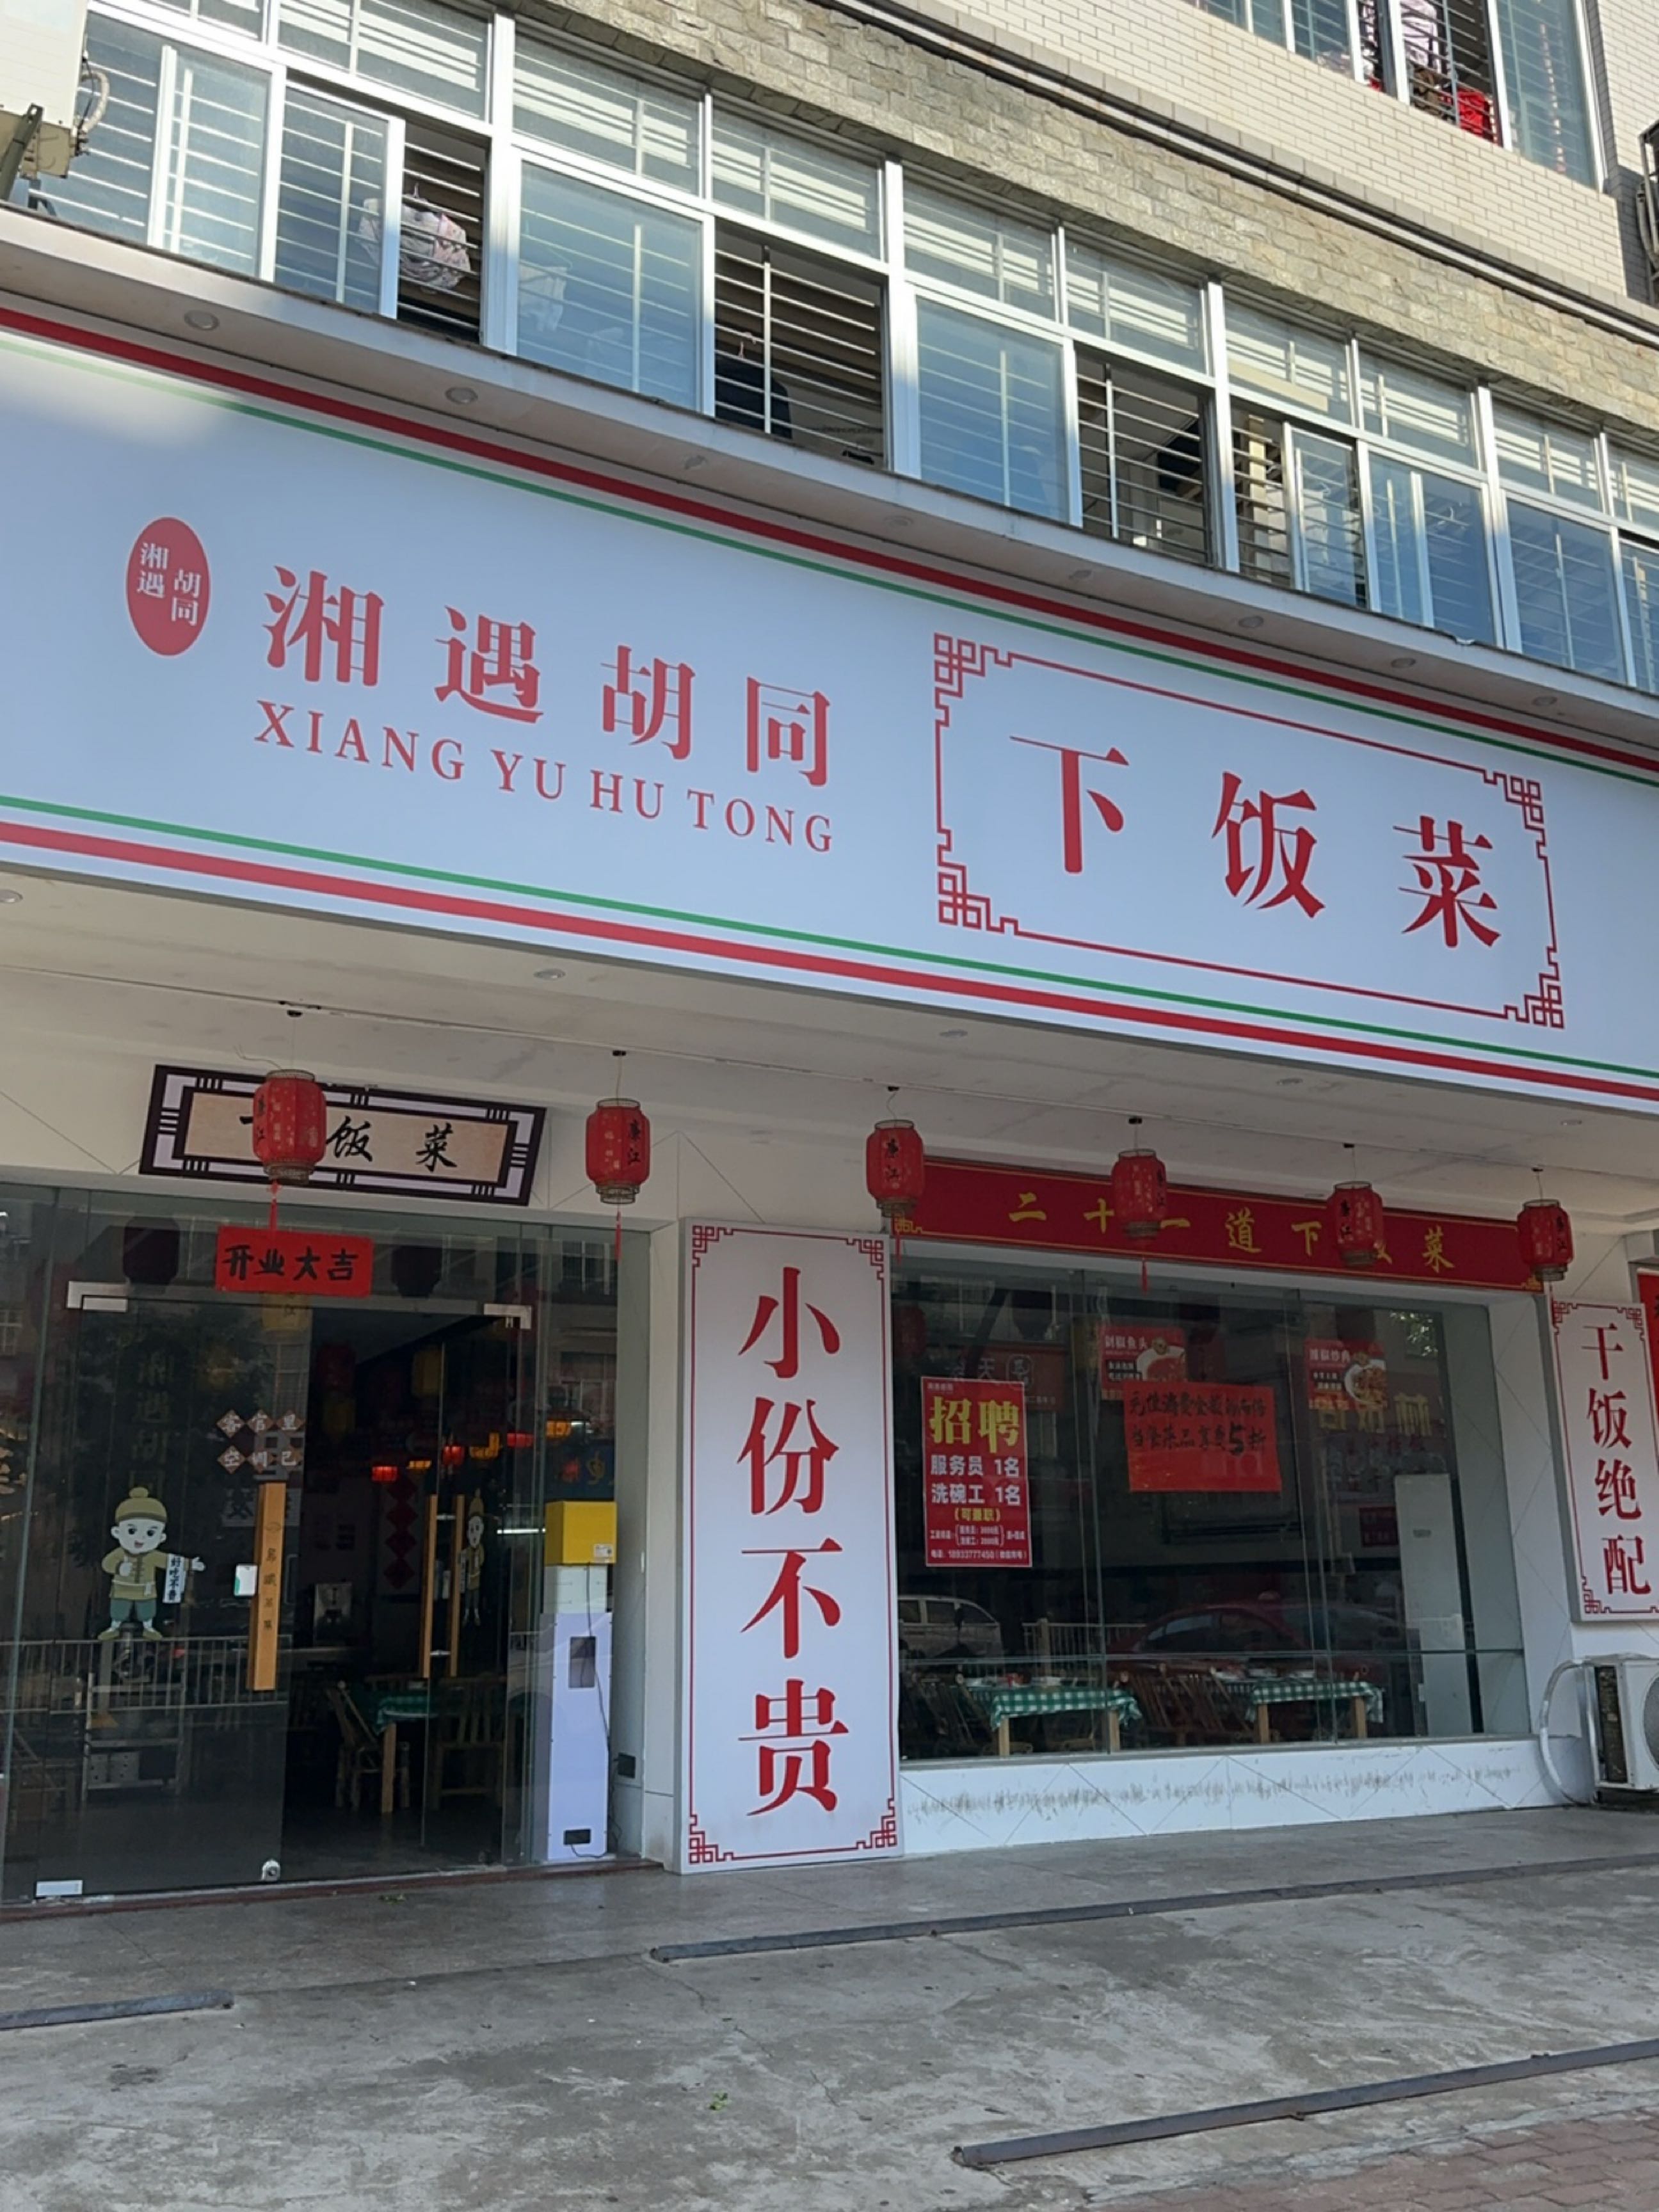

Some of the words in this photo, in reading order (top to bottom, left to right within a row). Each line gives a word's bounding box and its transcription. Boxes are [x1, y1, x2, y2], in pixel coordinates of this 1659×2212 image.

[137, 542, 169, 599] 湘遇
[171, 568, 201, 627] 胡同
[262, 565, 831, 787] 湘遇胡同
[254, 700, 465, 781] XIANG
[490, 749, 566, 801] YU
[589, 770, 665, 820] HU
[687, 789, 833, 854] TONG
[1009, 735, 1502, 949] 下饭菜
[240, 1114, 458, 1173] 饭菜
[1009, 1192, 1455, 1271] 二十一道下菜
[223, 1244, 359, 1281] 开业大吉
[929, 1395, 1020, 1454] 招聘
[931, 1455, 984, 1477] 服务员
[993, 1457, 1020, 1479] 1名
[1581, 1322, 1651, 1596] 干饭绝配
[931, 1482, 985, 1505] 洗碗工
[995, 1484, 1021, 1506] 1名
[737, 1266, 849, 1816] 小份不贵
